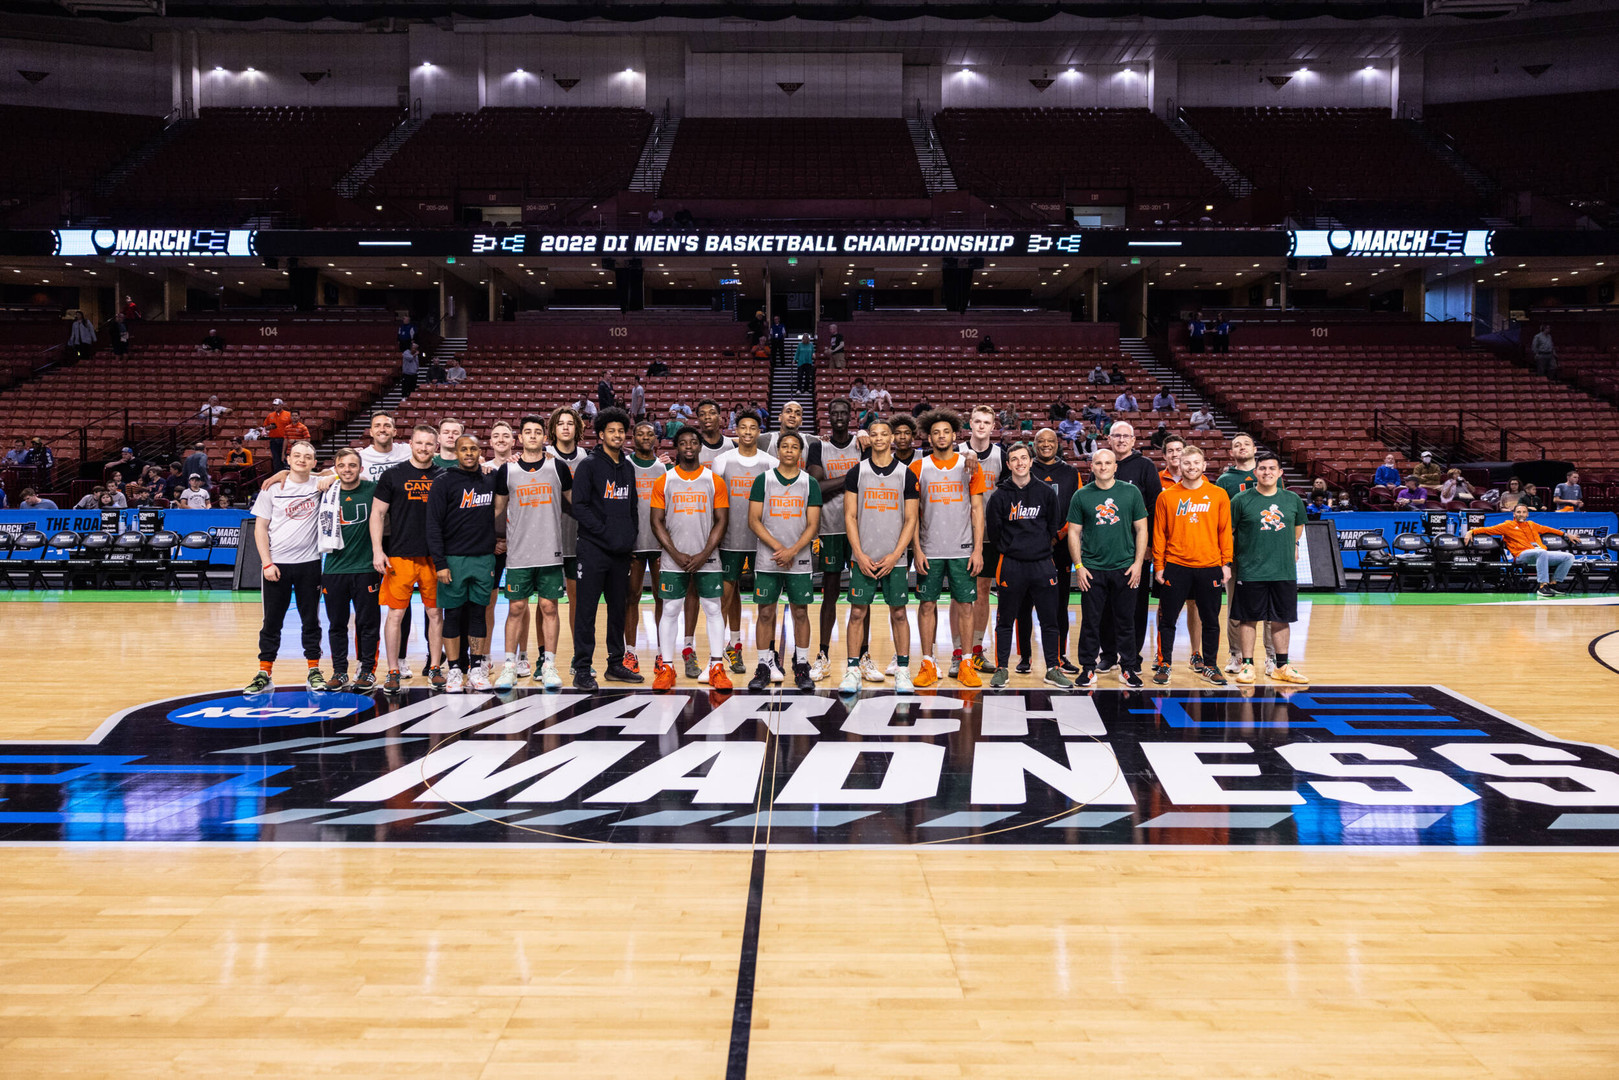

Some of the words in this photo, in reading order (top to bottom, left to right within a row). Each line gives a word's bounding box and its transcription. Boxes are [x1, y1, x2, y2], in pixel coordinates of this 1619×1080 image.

[115, 229, 192, 251] MARCH
[540, 235, 598, 252] 2022
[603, 235, 629, 252] DI
[635, 235, 700, 252] MEN'S
[704, 235, 838, 252] BASKETBALL
[843, 235, 1015, 252] CHAMPIONSHIP
[1351, 230, 1429, 251] MARCH
[259, 326, 279, 337] 104
[608, 327, 629, 337] 103
[959, 328, 979, 339] 102
[1310, 327, 1329, 337] 101
[404, 482, 433, 491] CAN
[516, 485, 552, 498] miami
[928, 484, 964, 494] miami
[460, 488, 493, 509] Miami
[672, 494, 708, 504] miami
[864, 490, 899, 500] miami
[769, 498, 804, 508] miami
[1176, 497, 1211, 516] Miami
[1009, 500, 1041, 521] Miami
[46, 517, 71, 531] THE
[73, 517, 100, 531] ROA
[1394, 521, 1419, 535] THE
[176, 706, 358, 719] NCAA
[336, 694, 1108, 737] MARCH
[330, 740, 1619, 807] MADNESS
